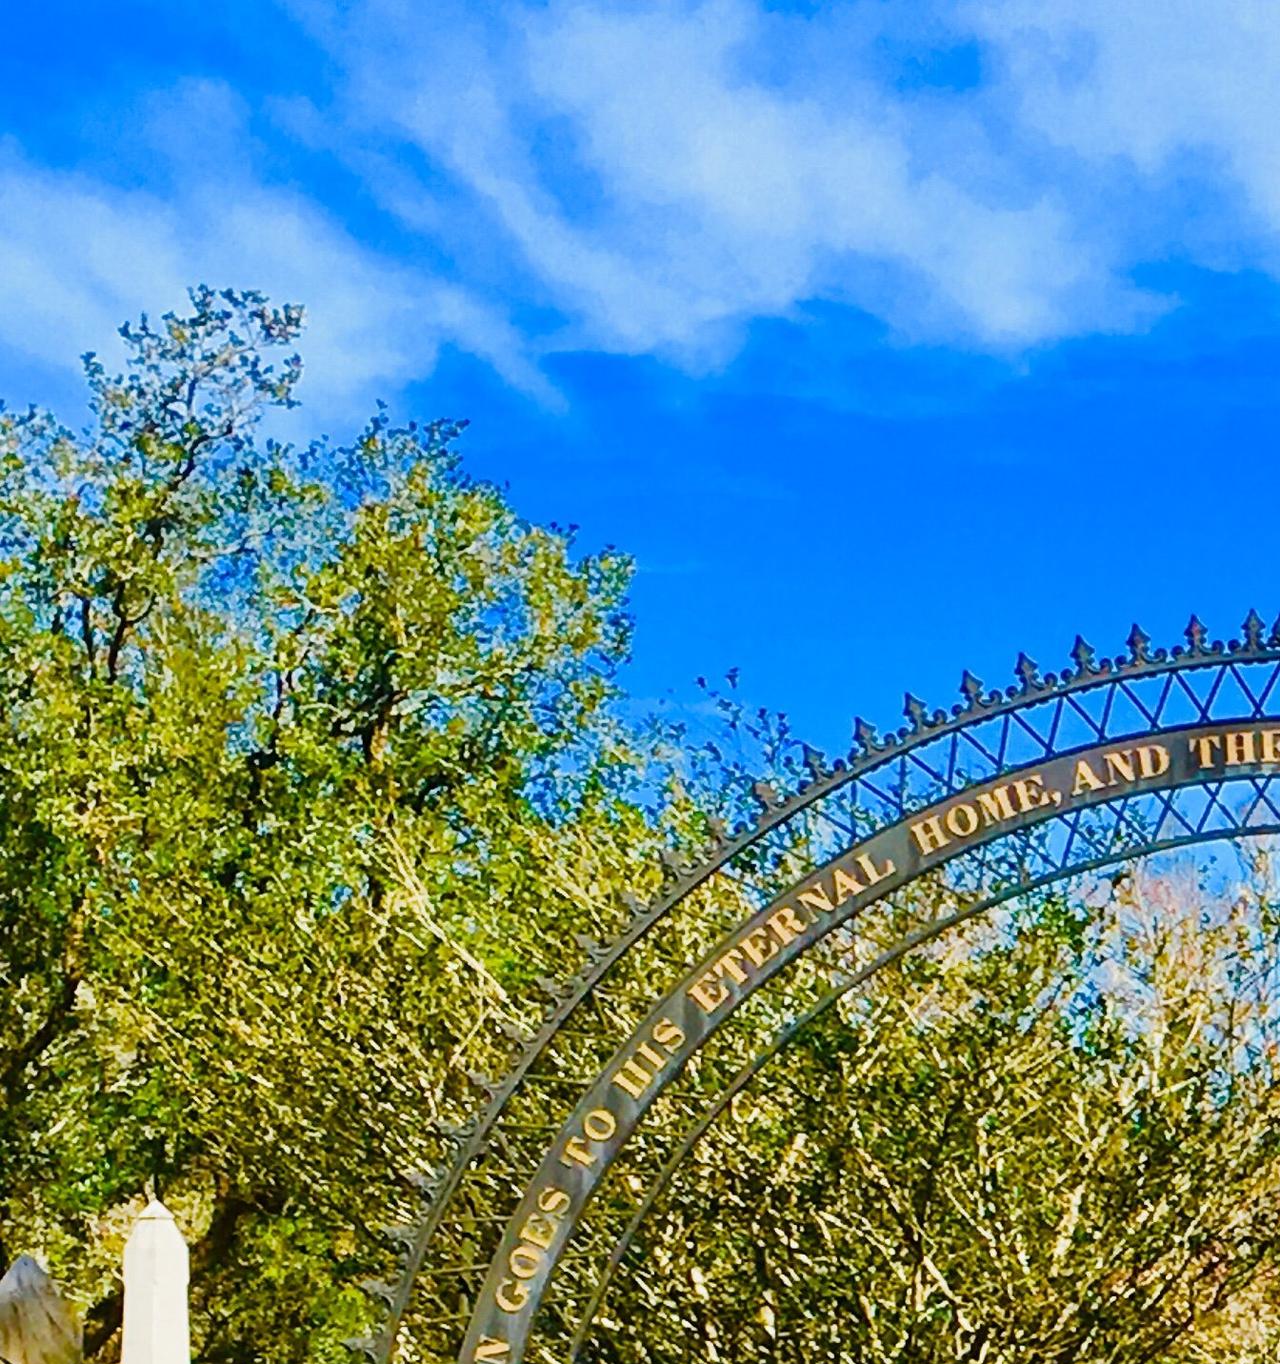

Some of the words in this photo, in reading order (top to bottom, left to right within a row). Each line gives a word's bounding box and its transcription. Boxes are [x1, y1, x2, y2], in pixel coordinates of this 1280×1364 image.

[495, 1186, 570, 1313] GOES
[563, 1109, 618, 1168] TO
[687, 852, 896, 1014] ETERNAL
[911, 773, 1062, 857] HOME,
[1070, 742, 1170, 799] AND
